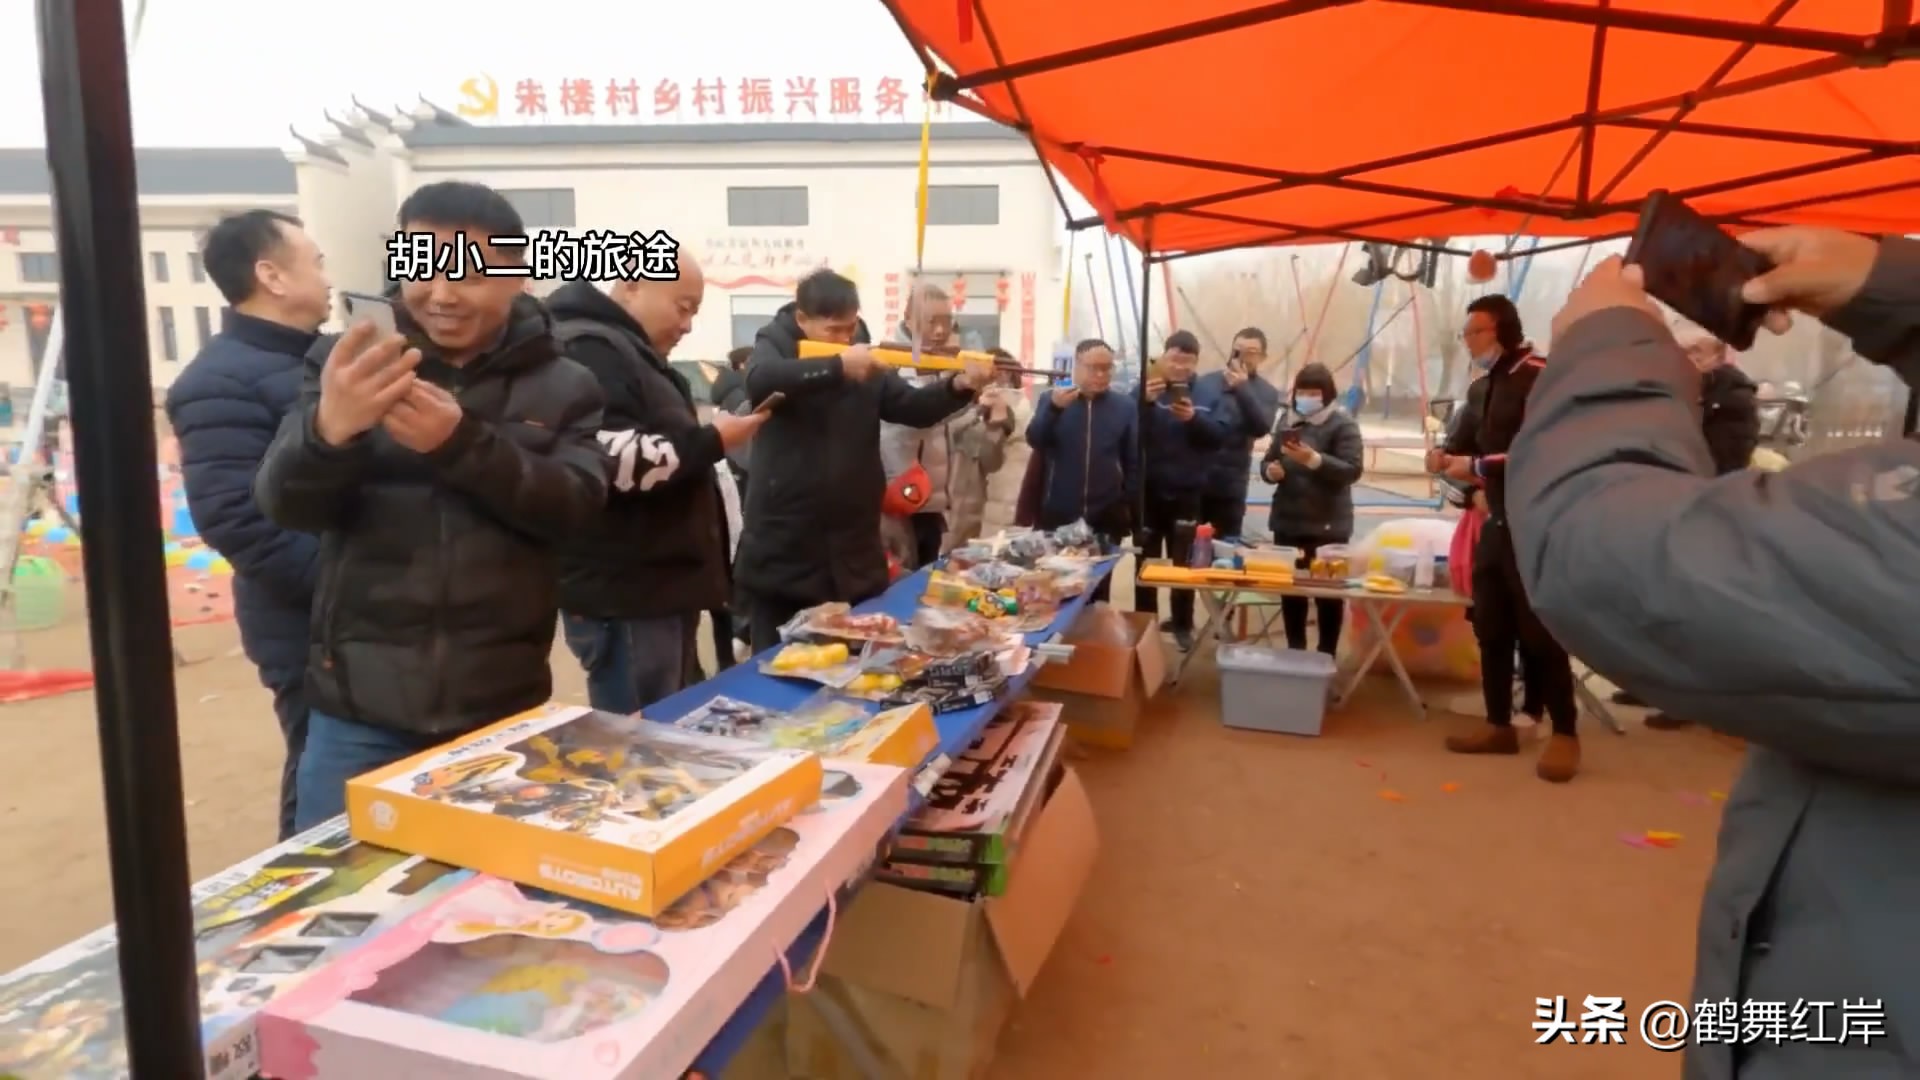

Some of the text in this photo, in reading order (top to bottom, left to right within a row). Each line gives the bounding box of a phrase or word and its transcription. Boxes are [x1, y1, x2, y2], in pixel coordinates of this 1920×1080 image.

[514, 75, 954, 116] 朱楼村乡村振兴服务
